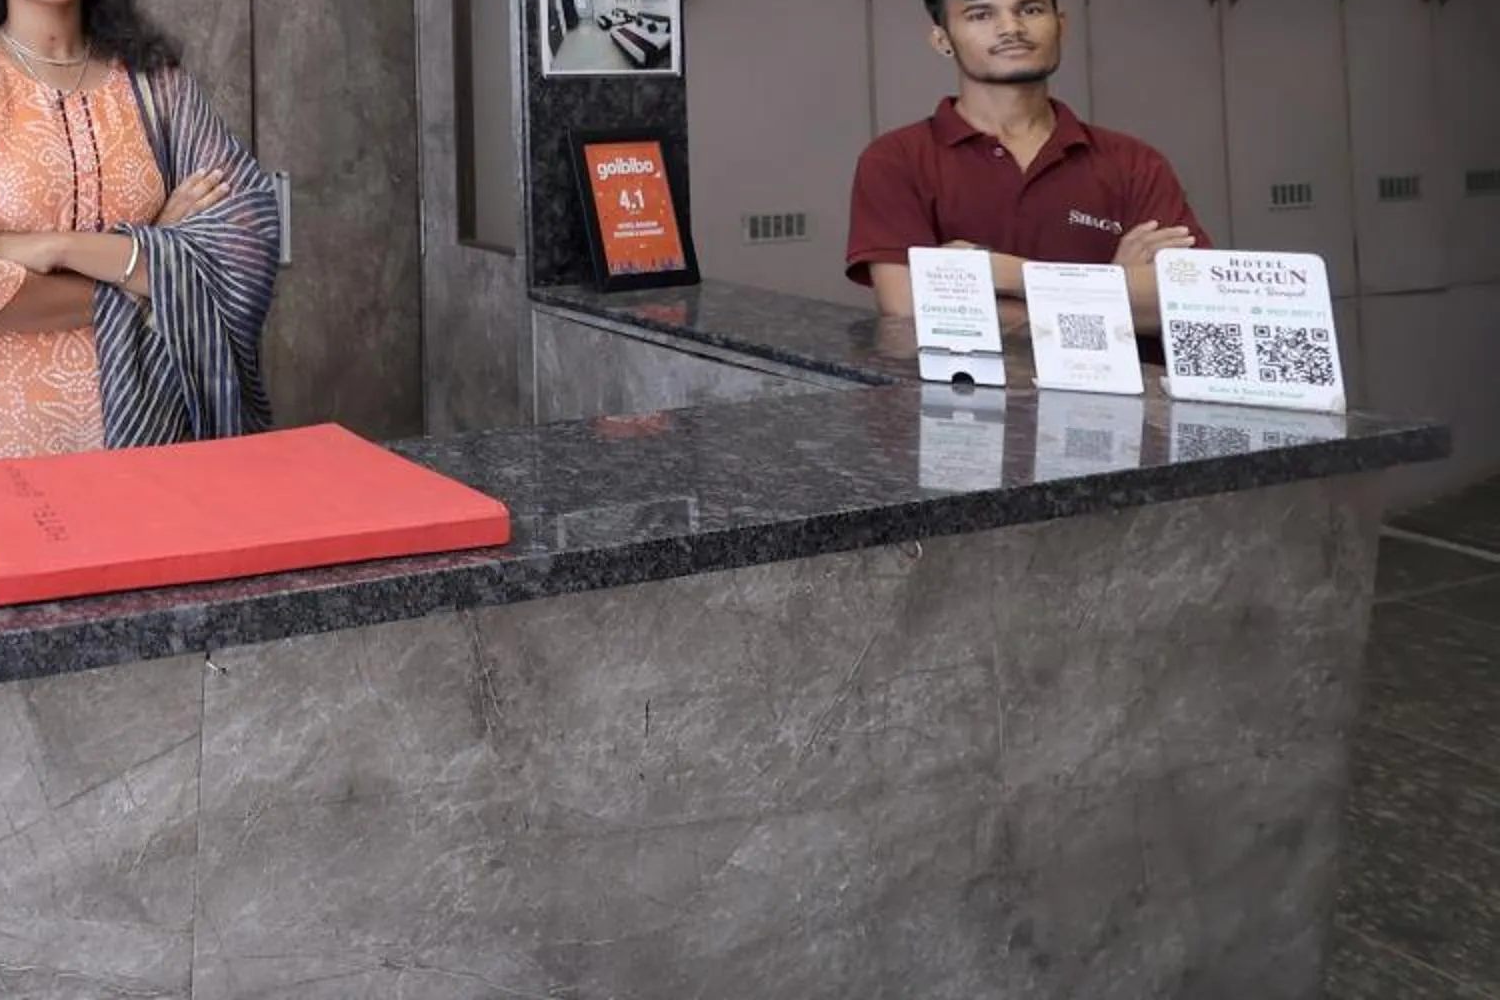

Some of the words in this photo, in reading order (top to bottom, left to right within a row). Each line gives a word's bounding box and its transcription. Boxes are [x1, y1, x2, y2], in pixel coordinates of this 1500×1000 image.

[597, 157, 654, 180] goibibo
[619, 188, 645, 209] 4.1
[1229, 257, 1287, 270] HOTEL
[1211, 266, 1307, 285] SHAGUN
